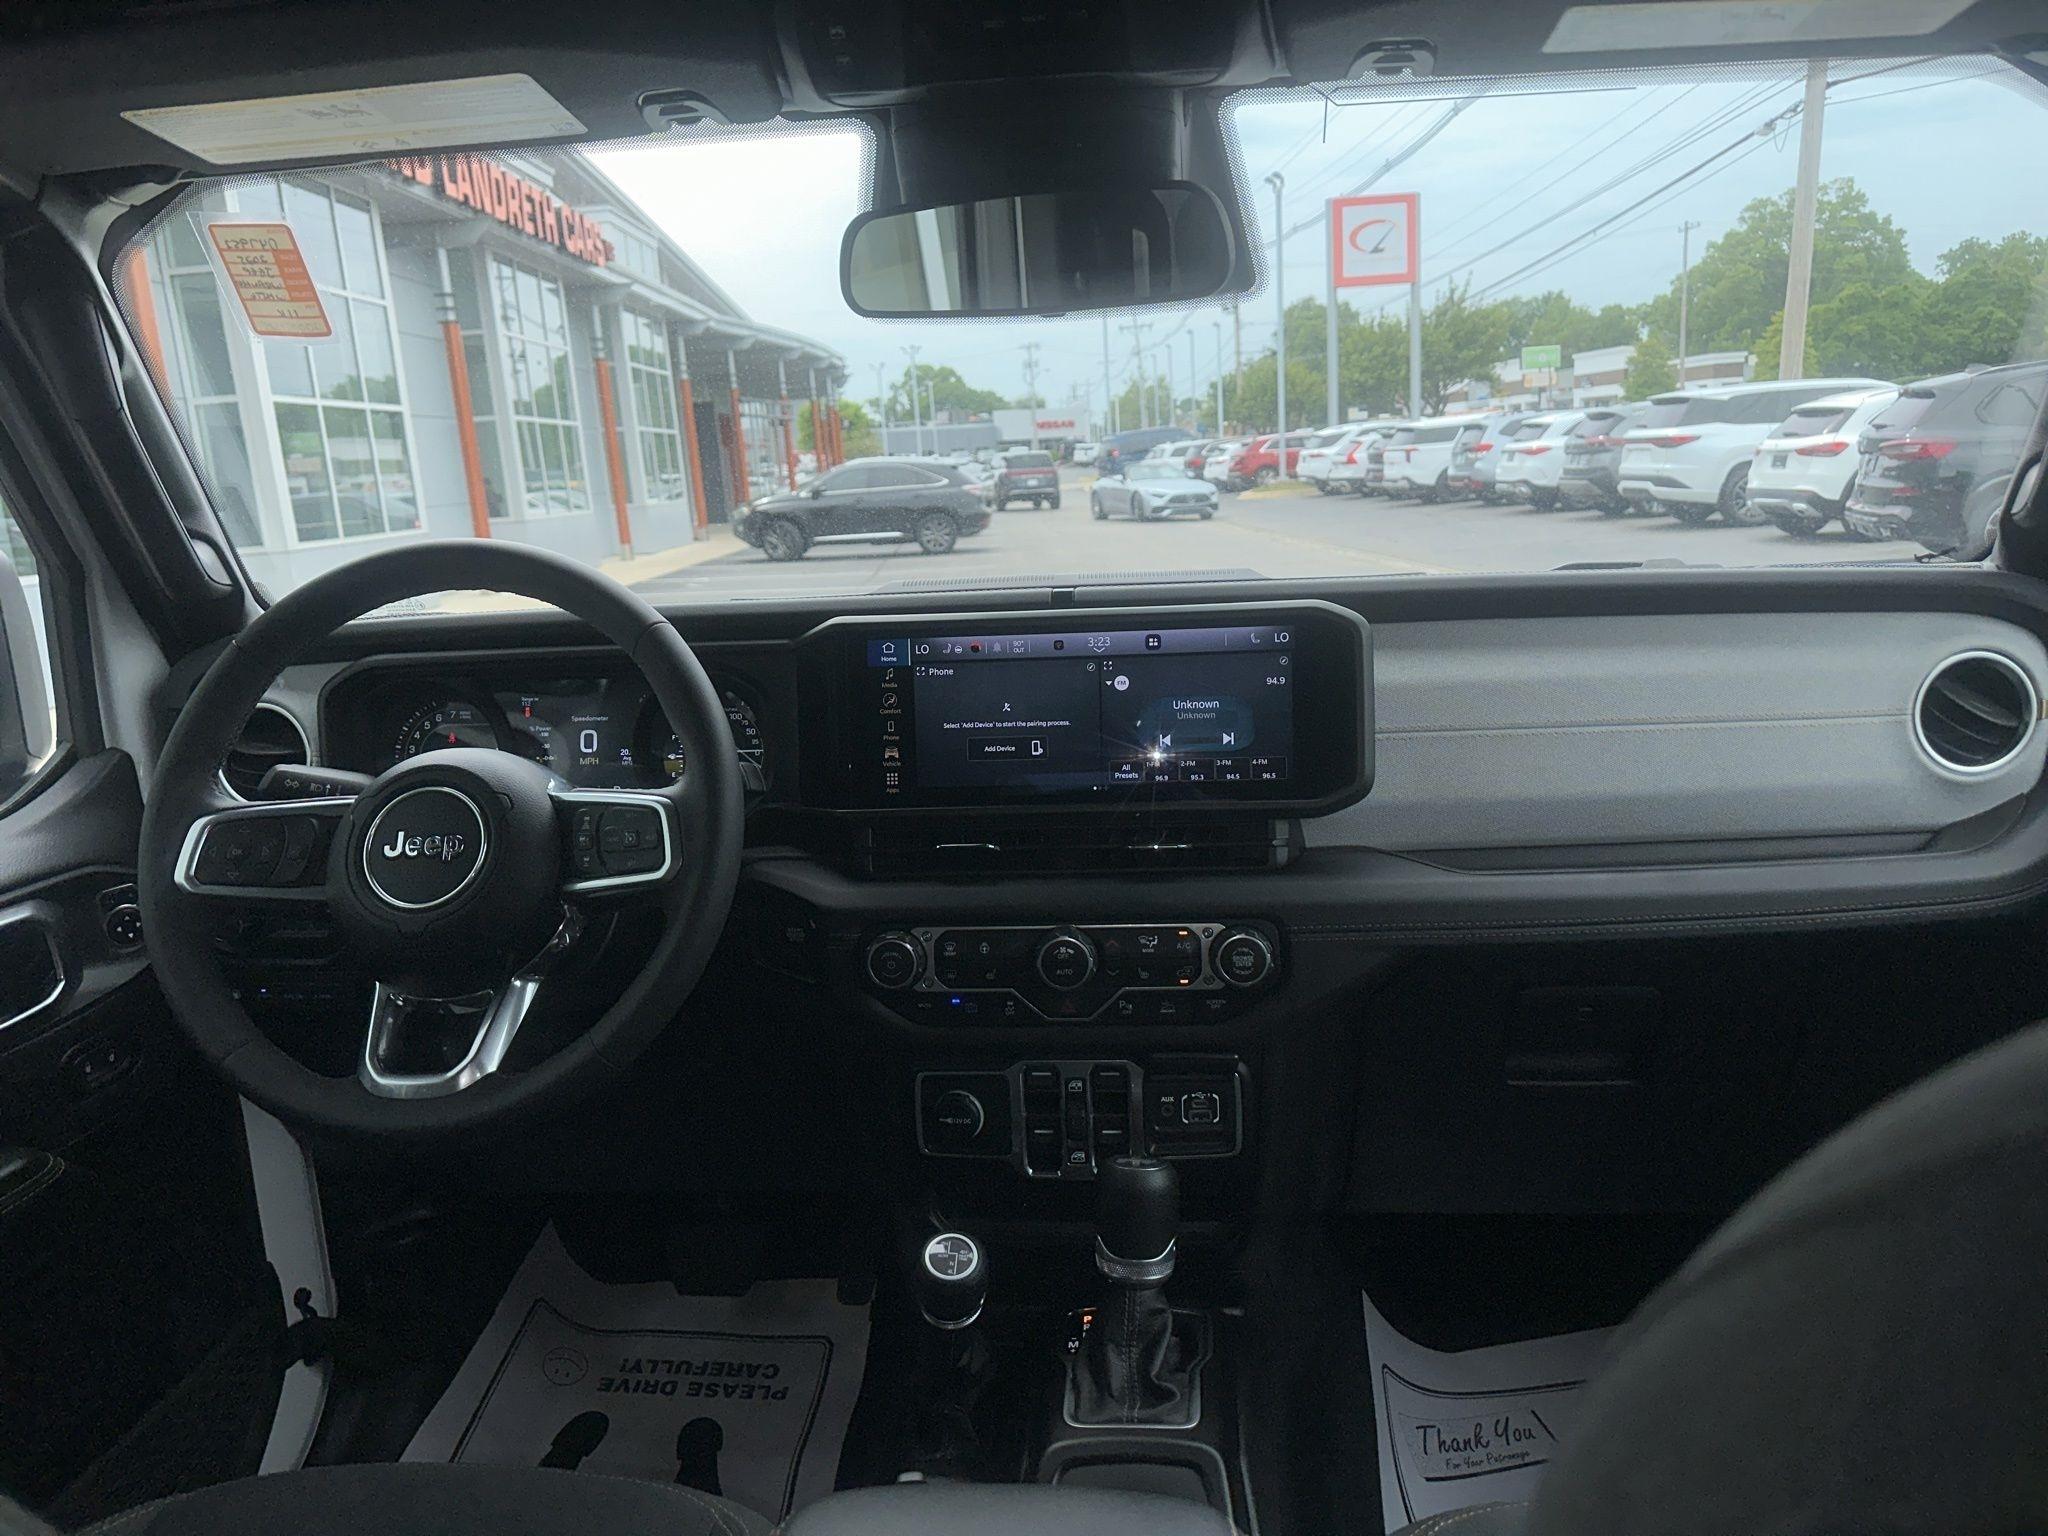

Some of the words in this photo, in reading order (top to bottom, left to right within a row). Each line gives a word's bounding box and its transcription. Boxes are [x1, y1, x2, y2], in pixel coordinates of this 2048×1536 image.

[441, 154, 560, 246] LANDRETH
[561, 203, 606, 267] CARS
[1088, 637, 1111, 647] 3:23
[1274, 633, 1290, 643] LO
[915, 644, 930, 655] LO
[929, 668, 954, 676] Phone
[1266, 677, 1286, 685] 94.9
[1173, 700, 1219, 710] Unknown
[436, 713, 442, 721] 6
[450, 710, 457, 719] 7
[1177, 711, 1216, 719] Unknown
[424, 721, 431, 729] 5
[1027, 720, 1047, 728] pairing
[414, 731, 420, 739] 4
[580, 729, 598, 753] 0
[409, 745, 415, 753] 3
[580, 757, 599, 765] MPH
[1114, 772, 1139, 780] Presets
[384, 831, 464, 860] Jeep
[1176, 943, 1191, 951] A/C
[1083, 1315, 1092, 1323] P
[1068, 1340, 1079, 1349] M
[619, 1358, 780, 1379] CAREFULLY!
[597, 1376, 679, 1396] DRIVE
[686, 1381, 790, 1401] PLEASE
[1416, 1423, 1490, 1456] Thank
[1494, 1416, 1537, 1446] You
[1446, 1457, 1462, 1471] For
[1464, 1456, 1485, 1470] Your
[1486, 1450, 1531, 1465] Patronage
